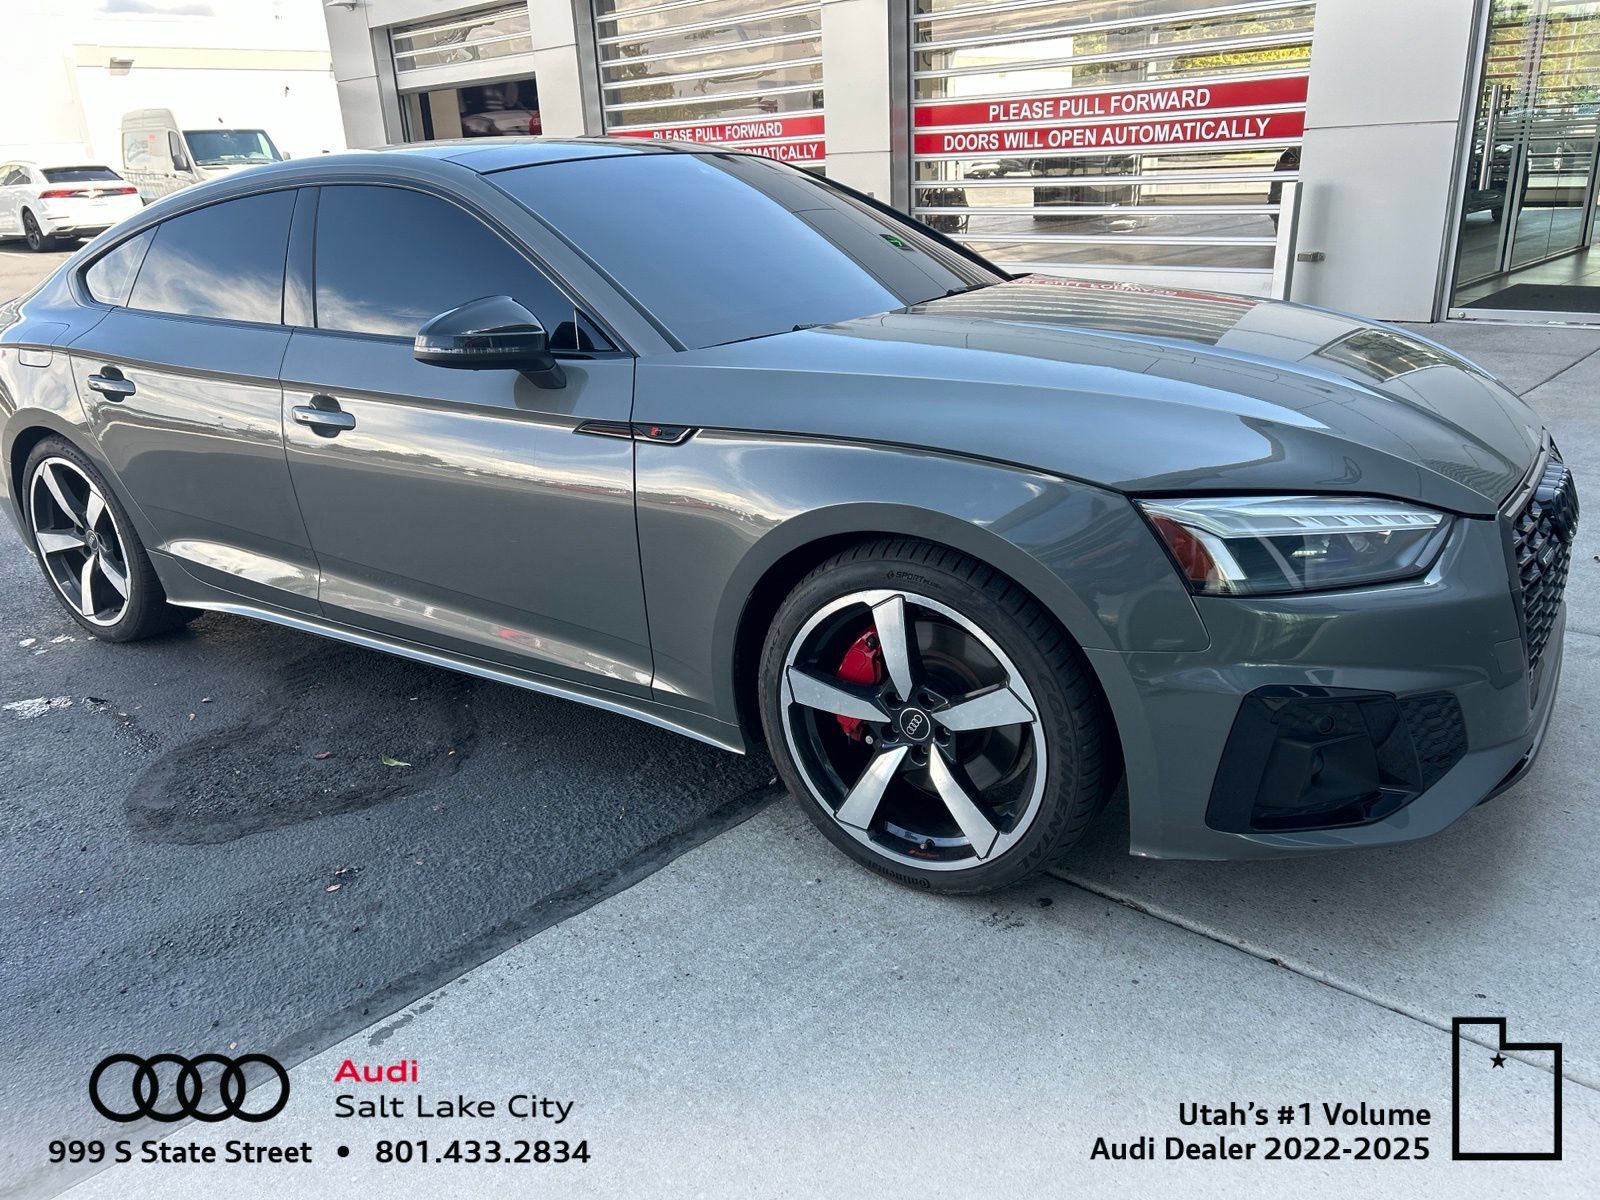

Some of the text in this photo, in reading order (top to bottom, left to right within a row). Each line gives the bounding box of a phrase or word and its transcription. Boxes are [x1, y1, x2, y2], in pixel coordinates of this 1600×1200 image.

[988, 88, 1211, 121] PLEASE PULL FORWARD
[695, 127, 724, 142] PULL
[725, 121, 783, 139] FORWARD
[943, 117, 1271, 151] DOORS WILL OPEN AUTOMATICALLY
